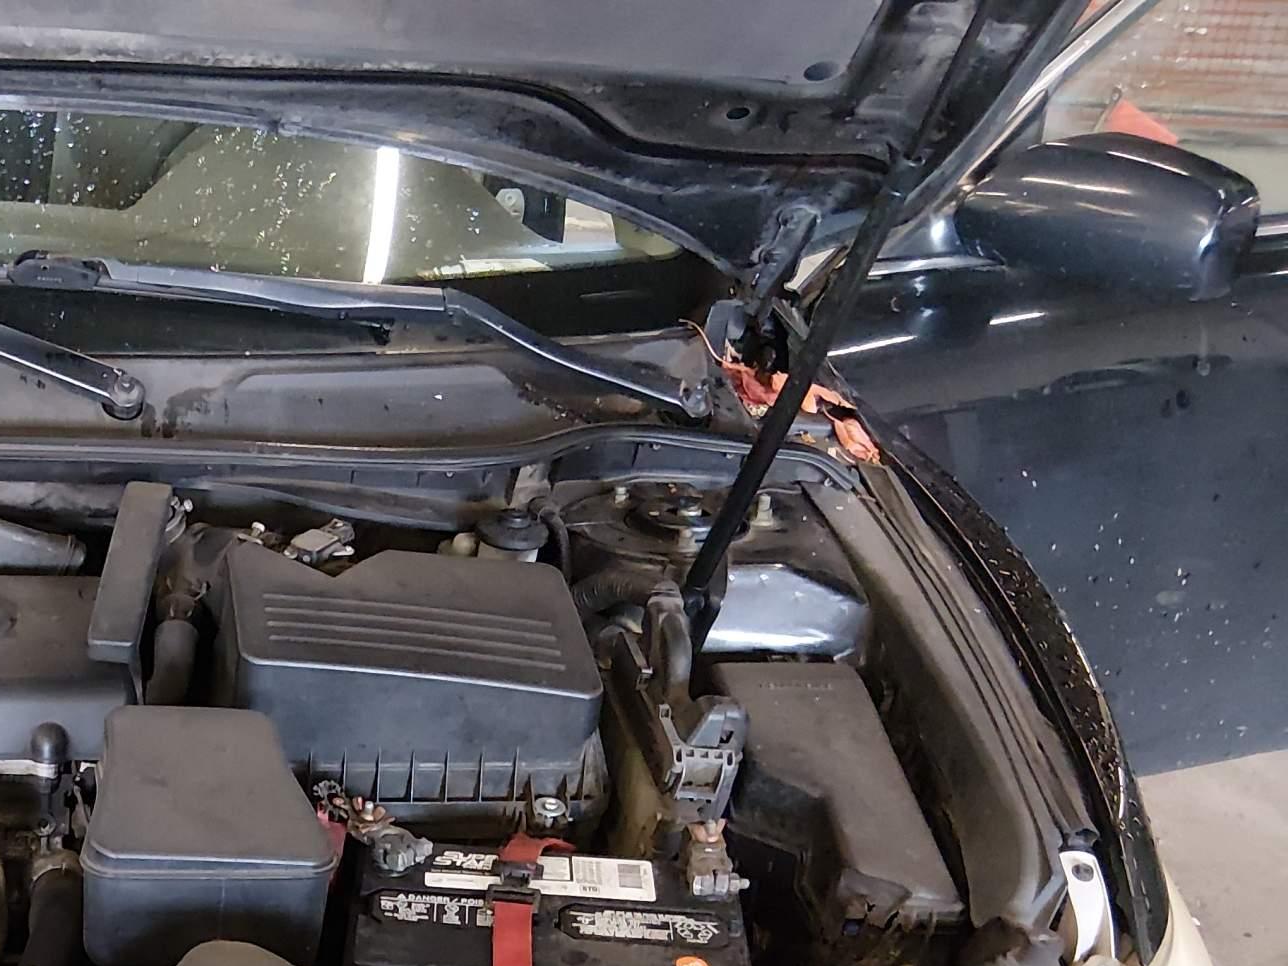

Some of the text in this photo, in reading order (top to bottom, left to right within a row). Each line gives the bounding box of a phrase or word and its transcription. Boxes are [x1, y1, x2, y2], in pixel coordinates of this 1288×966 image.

[432, 855, 492, 871] STAR
[443, 850, 499, 866] SUPE
[408, 893, 450, 904] DANGER
[461, 898, 485, 907] POIS
